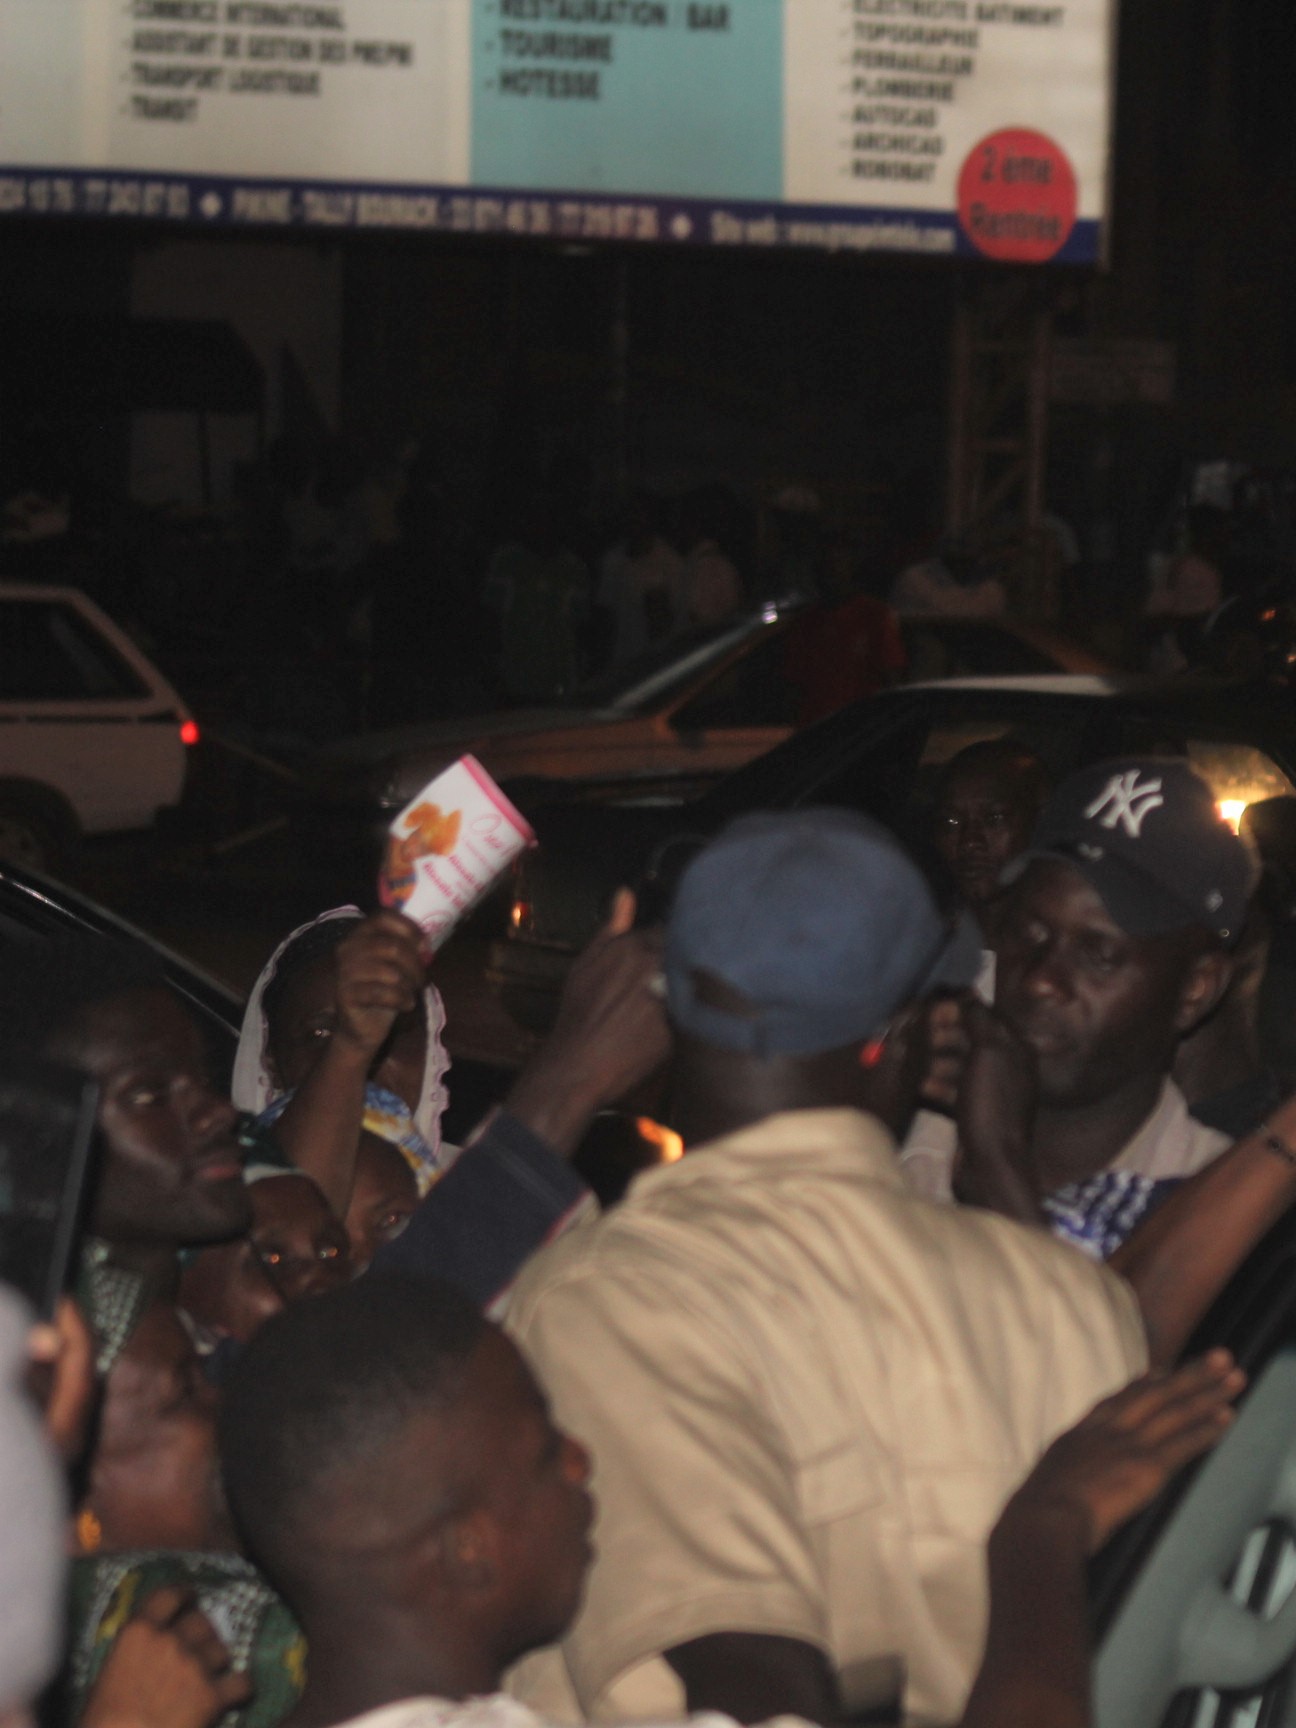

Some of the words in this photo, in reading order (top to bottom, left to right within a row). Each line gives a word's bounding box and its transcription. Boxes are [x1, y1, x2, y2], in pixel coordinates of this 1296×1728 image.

[499, 0, 667, 27] RESTAURATION
[686, 2, 730, 32] BAR
[499, 28, 613, 63] TOURISME
[852, 20, 980, 48] TOPOGRAPHIE
[132, 61, 223, 90] TRANSPORT
[851, 48, 974, 76] FERRAILLEUR
[499, 67, 601, 101] HOTESSE
[851, 76, 954, 102] PLOMBERIE
[131, 94, 198, 122] TRANSIT
[852, 103, 938, 128] AUTOCAD
[852, 130, 945, 156] ARCHICAD
[981, 145, 997, 183] 2
